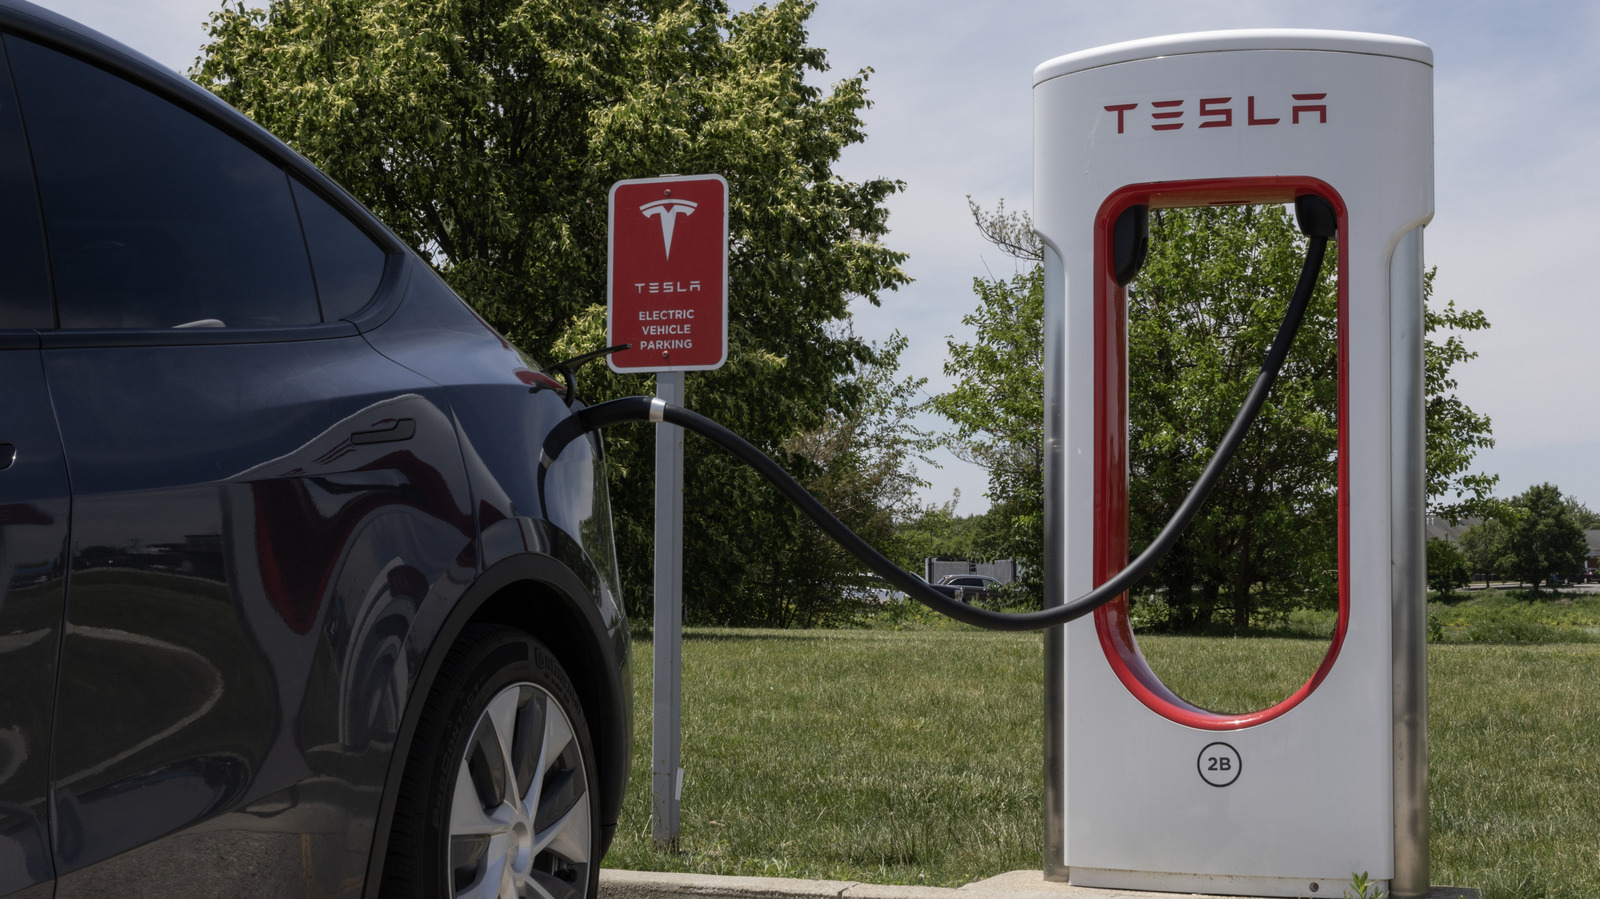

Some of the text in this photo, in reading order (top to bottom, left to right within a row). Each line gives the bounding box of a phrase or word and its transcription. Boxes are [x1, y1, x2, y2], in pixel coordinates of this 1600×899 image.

[1103, 92, 1328, 134] TESLA
[634, 280, 701, 294] TESLA
[638, 309, 695, 321] ELECTRIC
[641, 324, 691, 335] VEHICLE
[640, 339, 693, 350] PARKING
[1207, 757, 1232, 771] 2B
